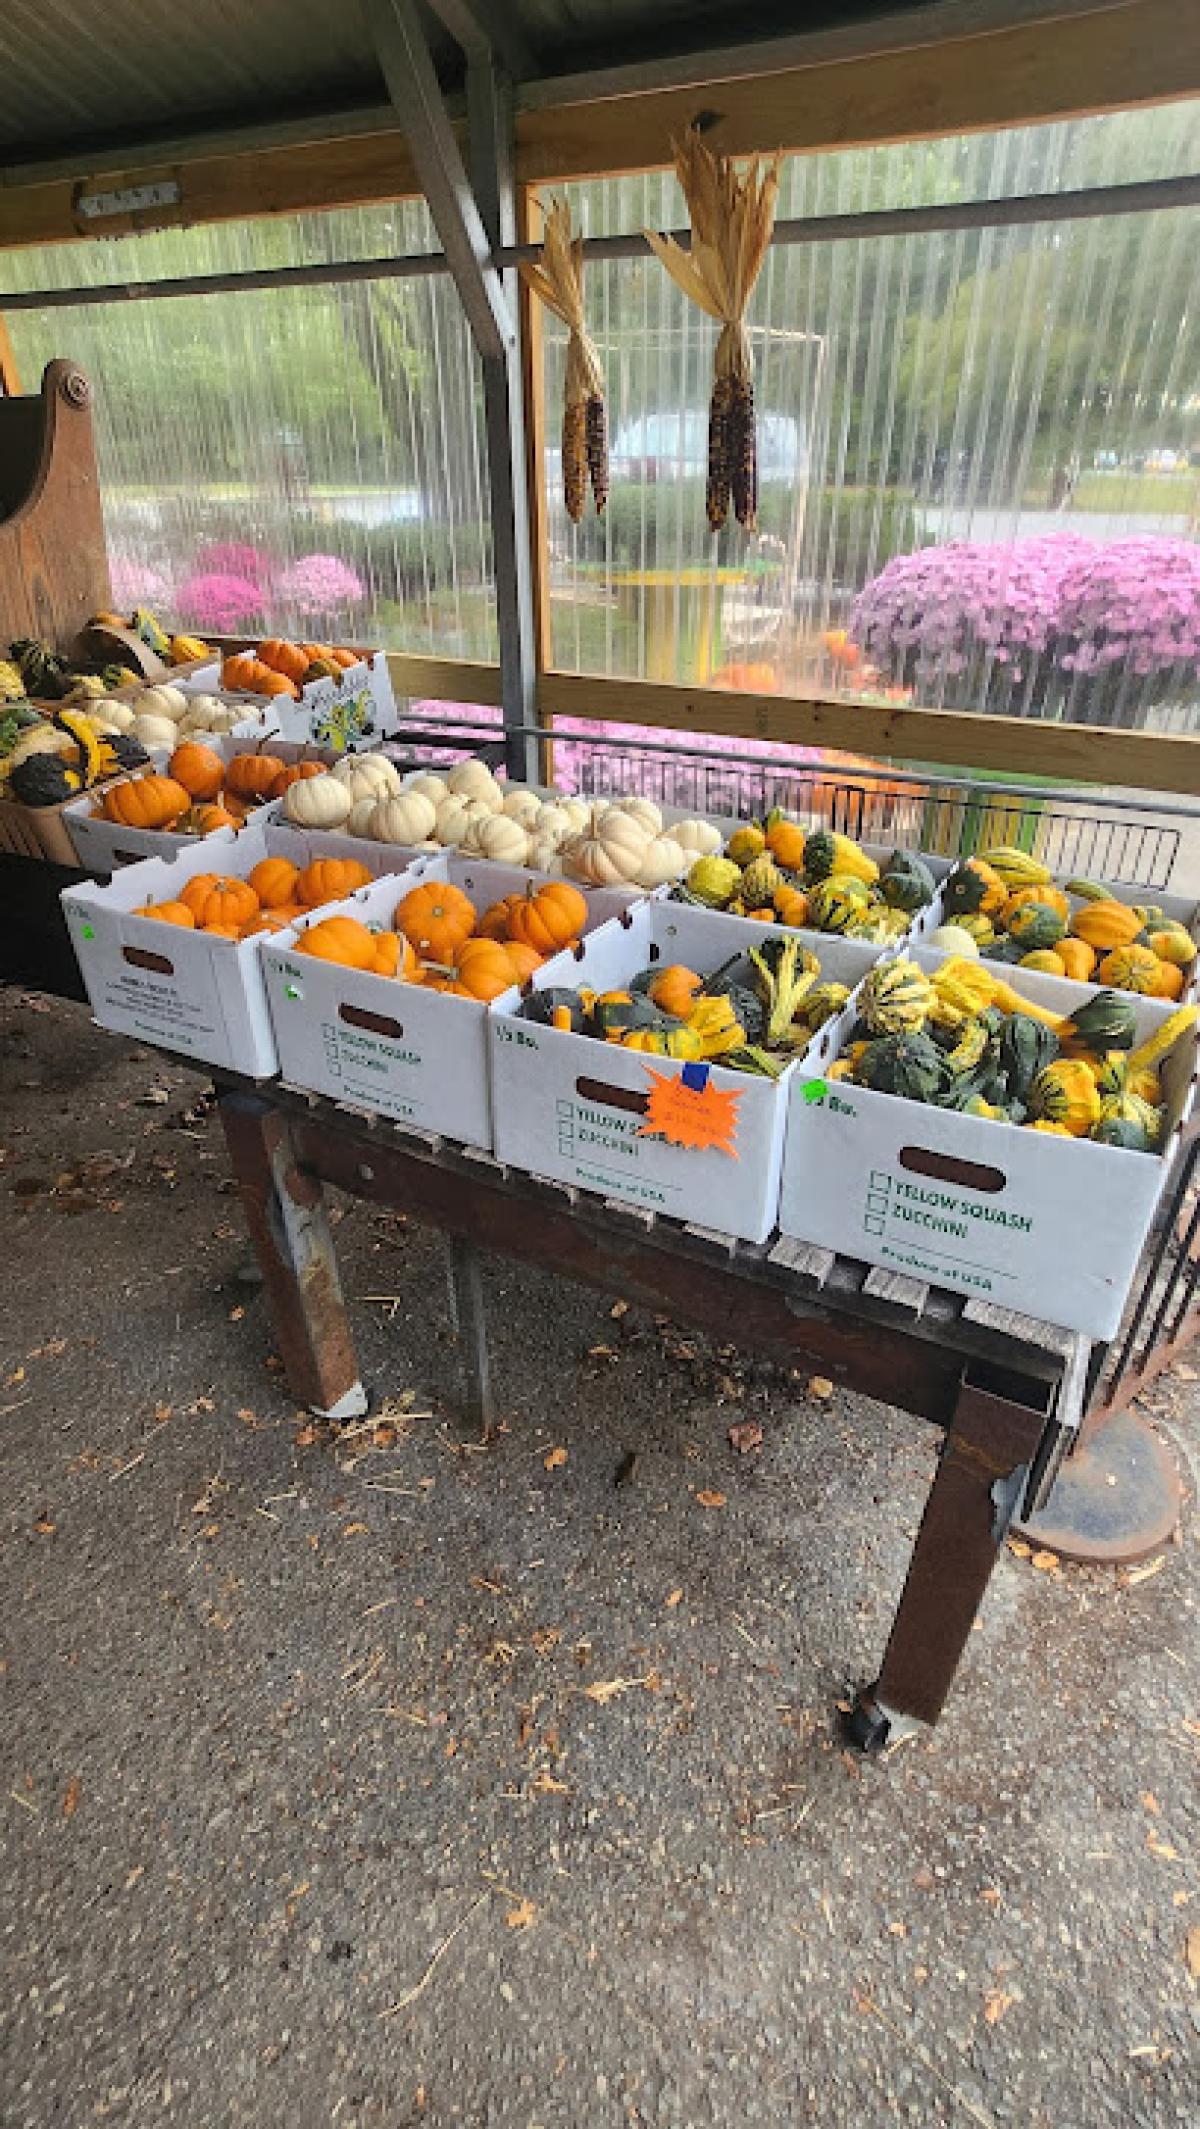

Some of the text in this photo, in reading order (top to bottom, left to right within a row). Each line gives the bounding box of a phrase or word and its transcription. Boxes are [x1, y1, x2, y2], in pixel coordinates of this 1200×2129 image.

[576, 1107, 626, 1133] YELLOW
[578, 1127, 639, 1157] ZUCCHINI
[640, 1187, 666, 1204] USA
[894, 1180, 1033, 1234] YELLOW SQUASH
[892, 1202, 968, 1238] ZUCCHINI
[881, 1246, 993, 1292] Produce of USA
